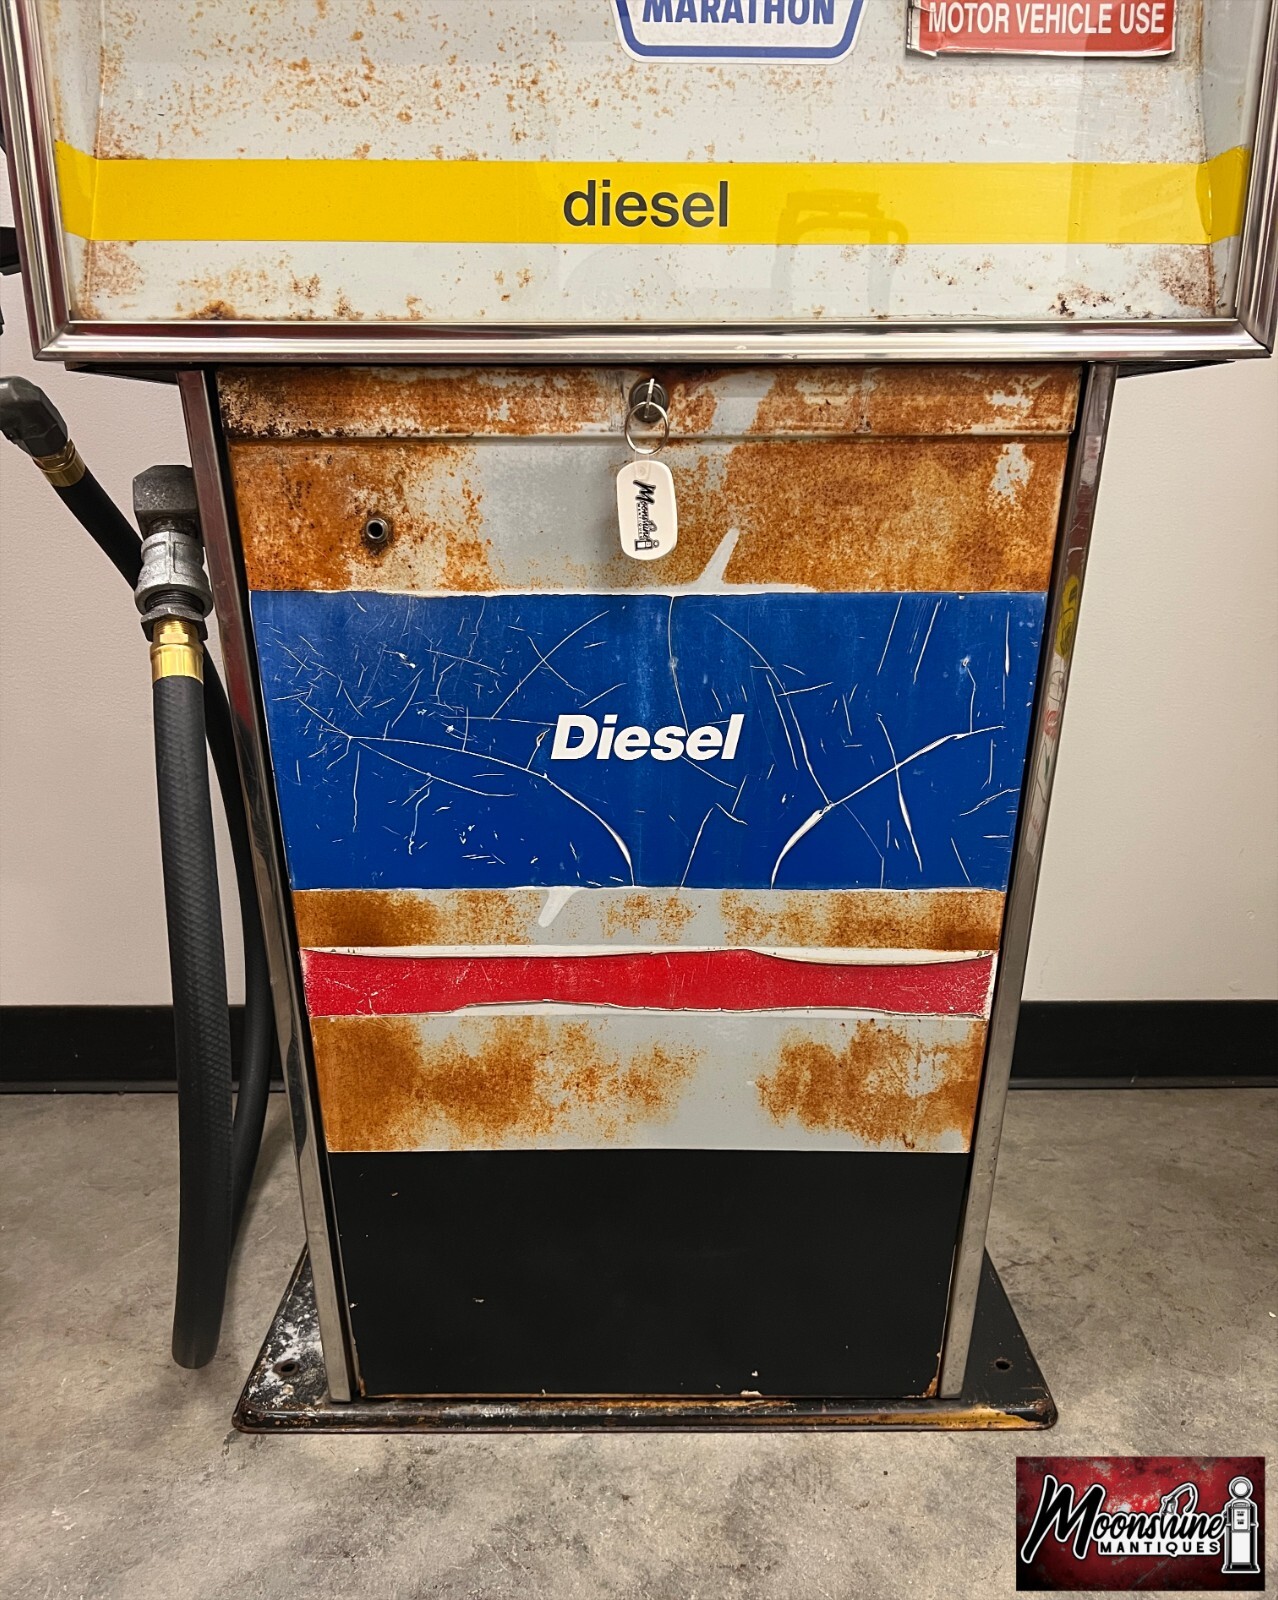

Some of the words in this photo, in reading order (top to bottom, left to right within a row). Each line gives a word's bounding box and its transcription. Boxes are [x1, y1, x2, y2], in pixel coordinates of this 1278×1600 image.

[642, 0, 834, 25] MARATHON
[928, 2, 1010, 34] MOTOR
[1016, 2, 1112, 34] VEHICLE
[1119, 2, 1165, 34] USE
[563, 179, 729, 227] diesel
[550, 714, 745, 761] Diesel
